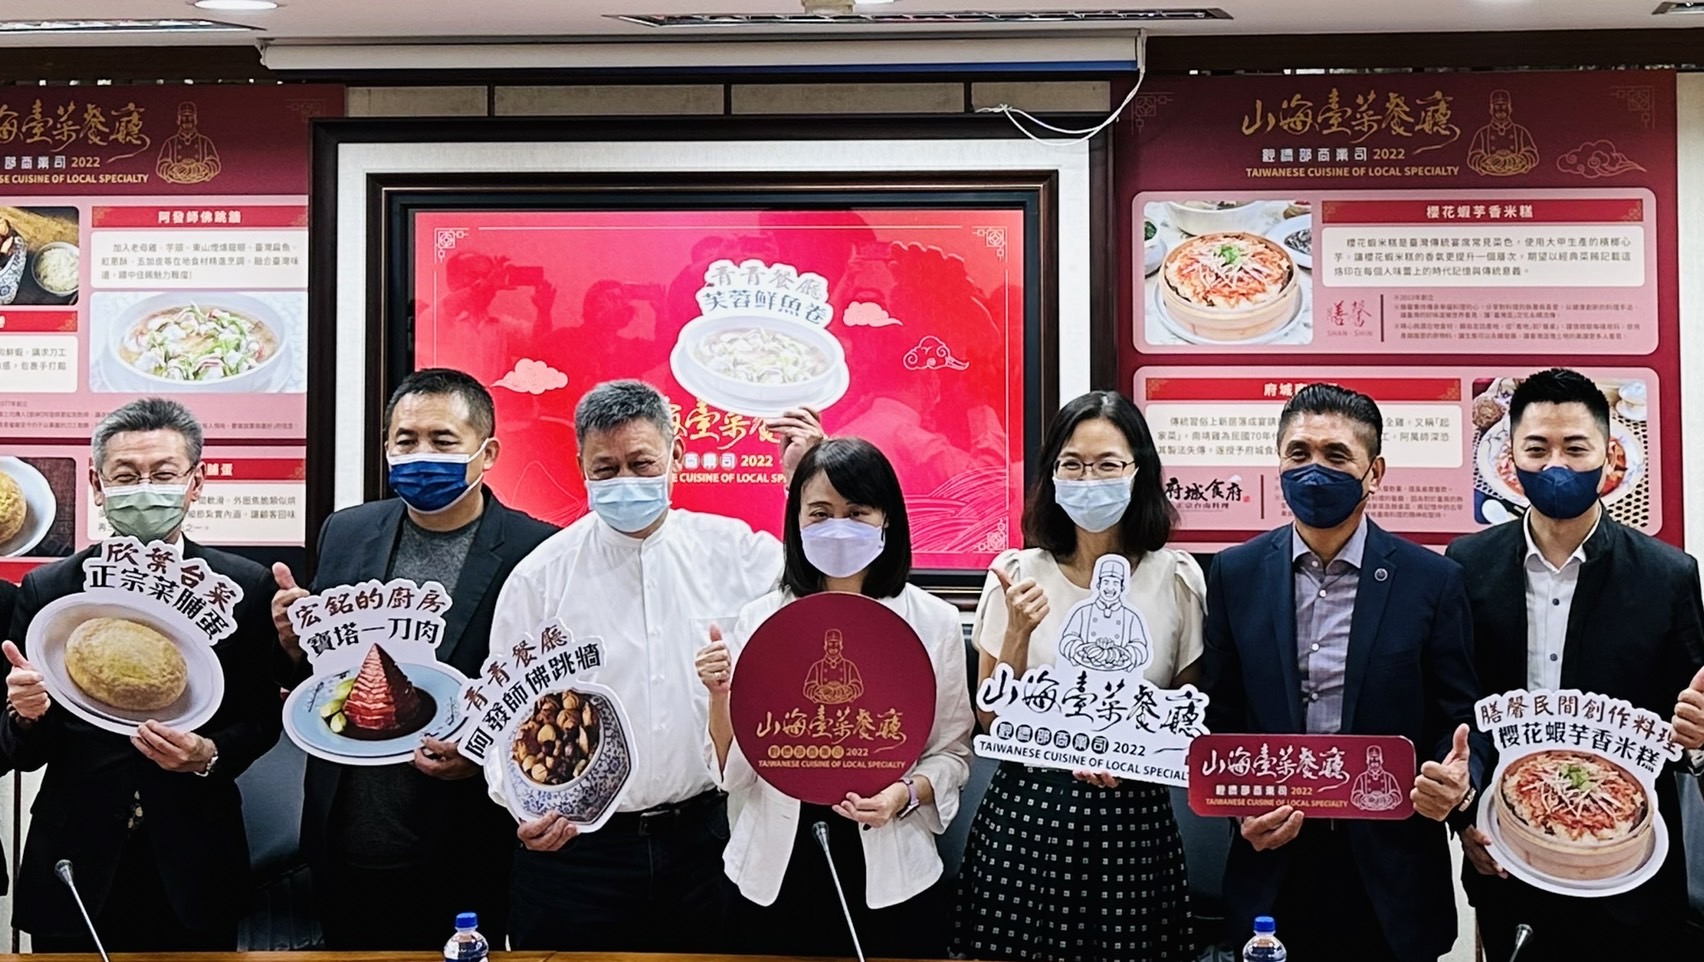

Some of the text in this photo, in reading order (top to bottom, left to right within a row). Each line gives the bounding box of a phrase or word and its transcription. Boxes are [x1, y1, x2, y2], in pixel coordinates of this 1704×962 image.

[1242, 88, 1461, 155] 山海臺菜餐廳
[71, 157, 100, 168] 2022
[1373, 148, 1405, 160] 2022
[12, 174, 51, 184] CUISINE
[52, 174, 65, 184] OF
[67, 174, 98, 184] LOCAL
[99, 174, 149, 184] SPECIALTY
[1246, 166, 1460, 178] TAIWANESE CUISINE OF LOCAL SPECIALTY
[1426, 204, 1534, 220] 櫻花蝦芋香米糕
[711, 265, 823, 301] 青青餐廳
[703, 290, 827, 325] 芙蓉鮮魚卷
[680, 473, 719, 483] CUISINE
[721, 473, 735, 483] OF
[737, 473, 770, 483] LOCAL
[741, 455, 773, 467] 2022
[1164, 477, 1242, 501] 府城食府
[107, 543, 237, 613] 欣葉台菜
[88, 565, 229, 640] 正宗菜脯蛋
[295, 586, 446, 629] 宏銘的廚房
[307, 618, 439, 657] 寶塔一刀肉
[464, 624, 568, 711] 青青餐廳
[465, 643, 600, 759] 阿發師佛跳牆
[983, 670, 1211, 740] 山海臺菜餐廳
[756, 705, 907, 753] 山海臺菜餐廳
[1480, 695, 1677, 756] 膳馨民間創作料理
[758, 760, 799, 768] TAIWANESE
[801, 760, 830, 768] CUISINE
[868, 761, 906, 769] SPECIALTY
[846, 748, 869, 756] 2022
[979, 741, 1189, 781] TAIWANESE CUISINE OF LOCAL SPECIAL
[1113, 741, 1145, 757] 2022
[1498, 722, 1661, 773] 櫻花蝦芋香米糕
[1202, 743, 1350, 792] 山海臺菜餐廳
[1206, 798, 1245, 806] TAIWANESE
[1291, 787, 1313, 796] 2022
